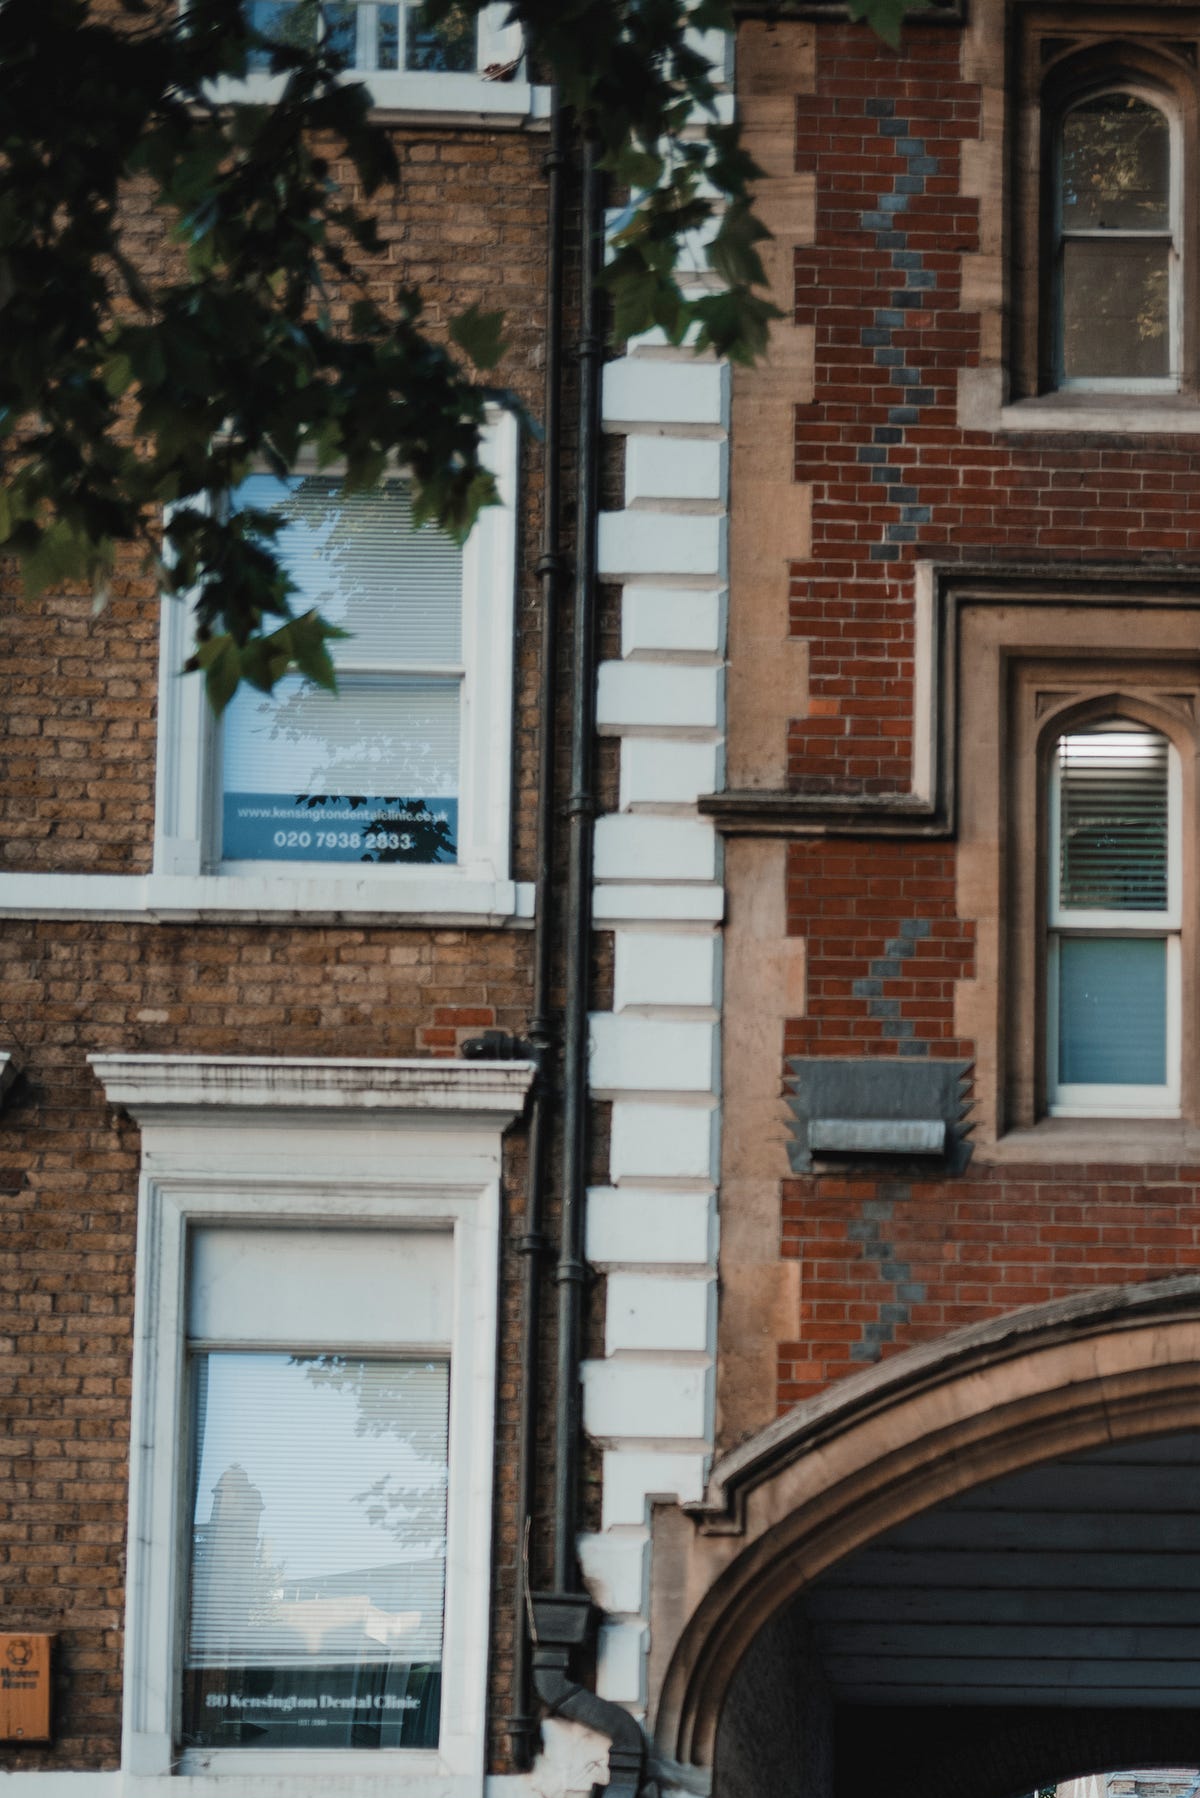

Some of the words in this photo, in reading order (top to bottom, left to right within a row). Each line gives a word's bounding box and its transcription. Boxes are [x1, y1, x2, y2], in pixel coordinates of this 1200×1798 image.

[273, 831, 311, 848] 020
[316, 832, 361, 849] 7938
[365, 833, 412, 850] 2833
[205, 1694, 227, 1708] 80
[230, 1694, 318, 1712] Kensington
[319, 1694, 372, 1709] Dental
[373, 1694, 421, 1709] Clinic
